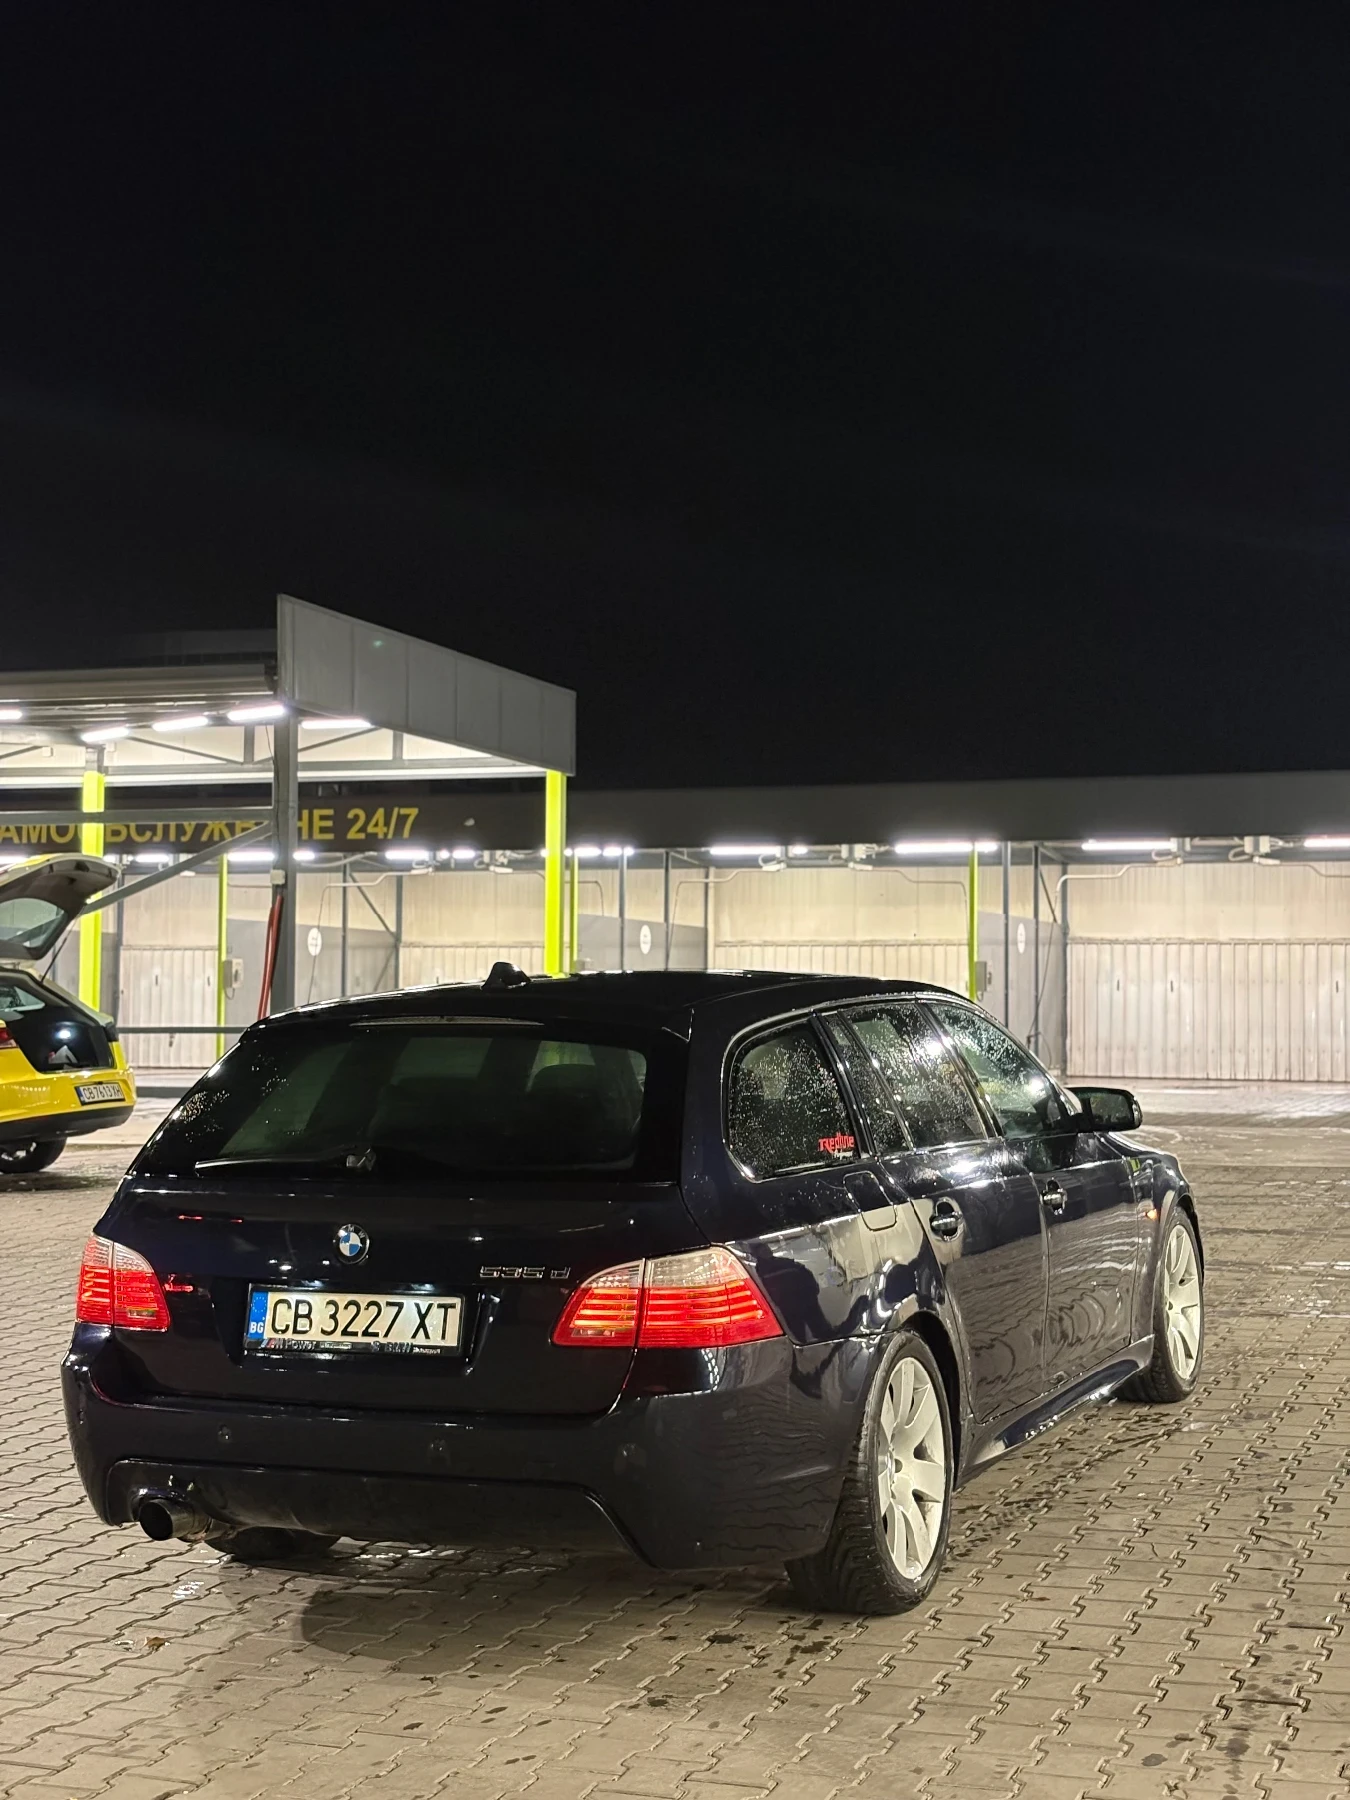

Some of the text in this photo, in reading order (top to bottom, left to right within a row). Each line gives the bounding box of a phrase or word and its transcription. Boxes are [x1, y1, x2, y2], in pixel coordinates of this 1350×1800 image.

[346, 807, 419, 839] 24/7
[480, 1266, 545, 1278] 535
[250, 1321, 264, 1333] BG
[271, 1298, 457, 1340] CB 3227 XT
